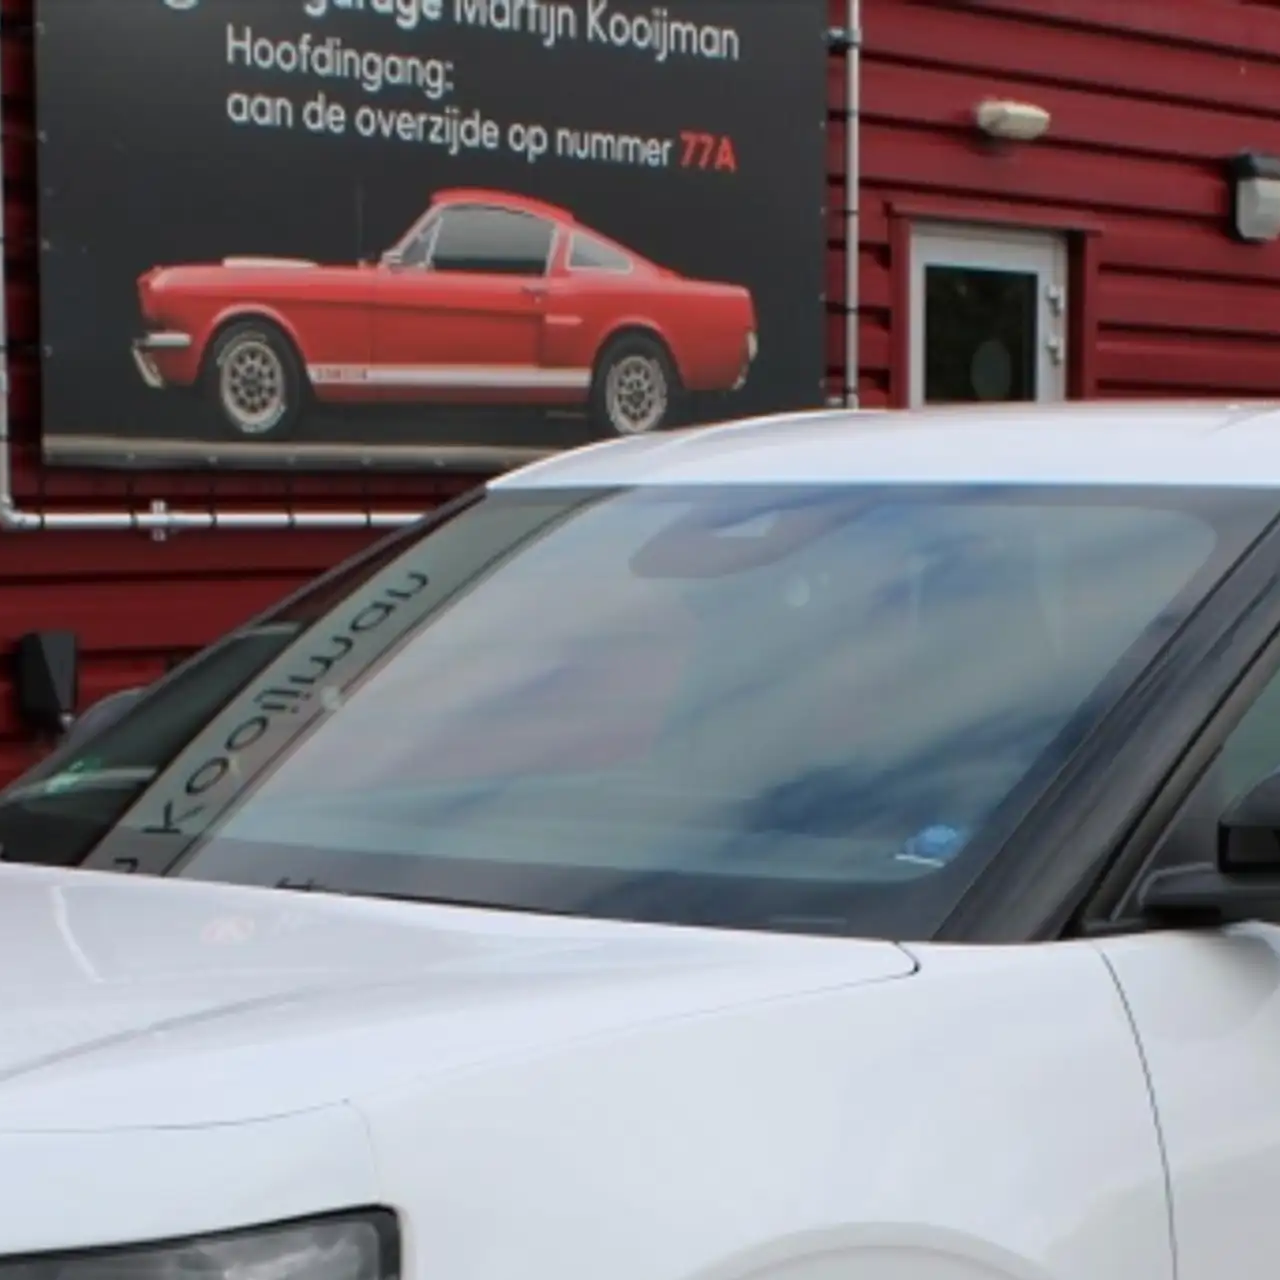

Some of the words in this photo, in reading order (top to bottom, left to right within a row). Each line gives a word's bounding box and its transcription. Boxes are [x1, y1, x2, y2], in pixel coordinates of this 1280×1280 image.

[226, 23, 455, 99] Hoofdingang:
[454, 0, 577, 48] Martijn
[587, 0, 740, 62] Kooijman
[227, 92, 293, 128] aan
[302, 91, 346, 133] de
[355, 106, 499, 155] overzijde
[508, 123, 548, 163] op
[556, 127, 673, 166] nummer
[680, 130, 738, 172] 77A
